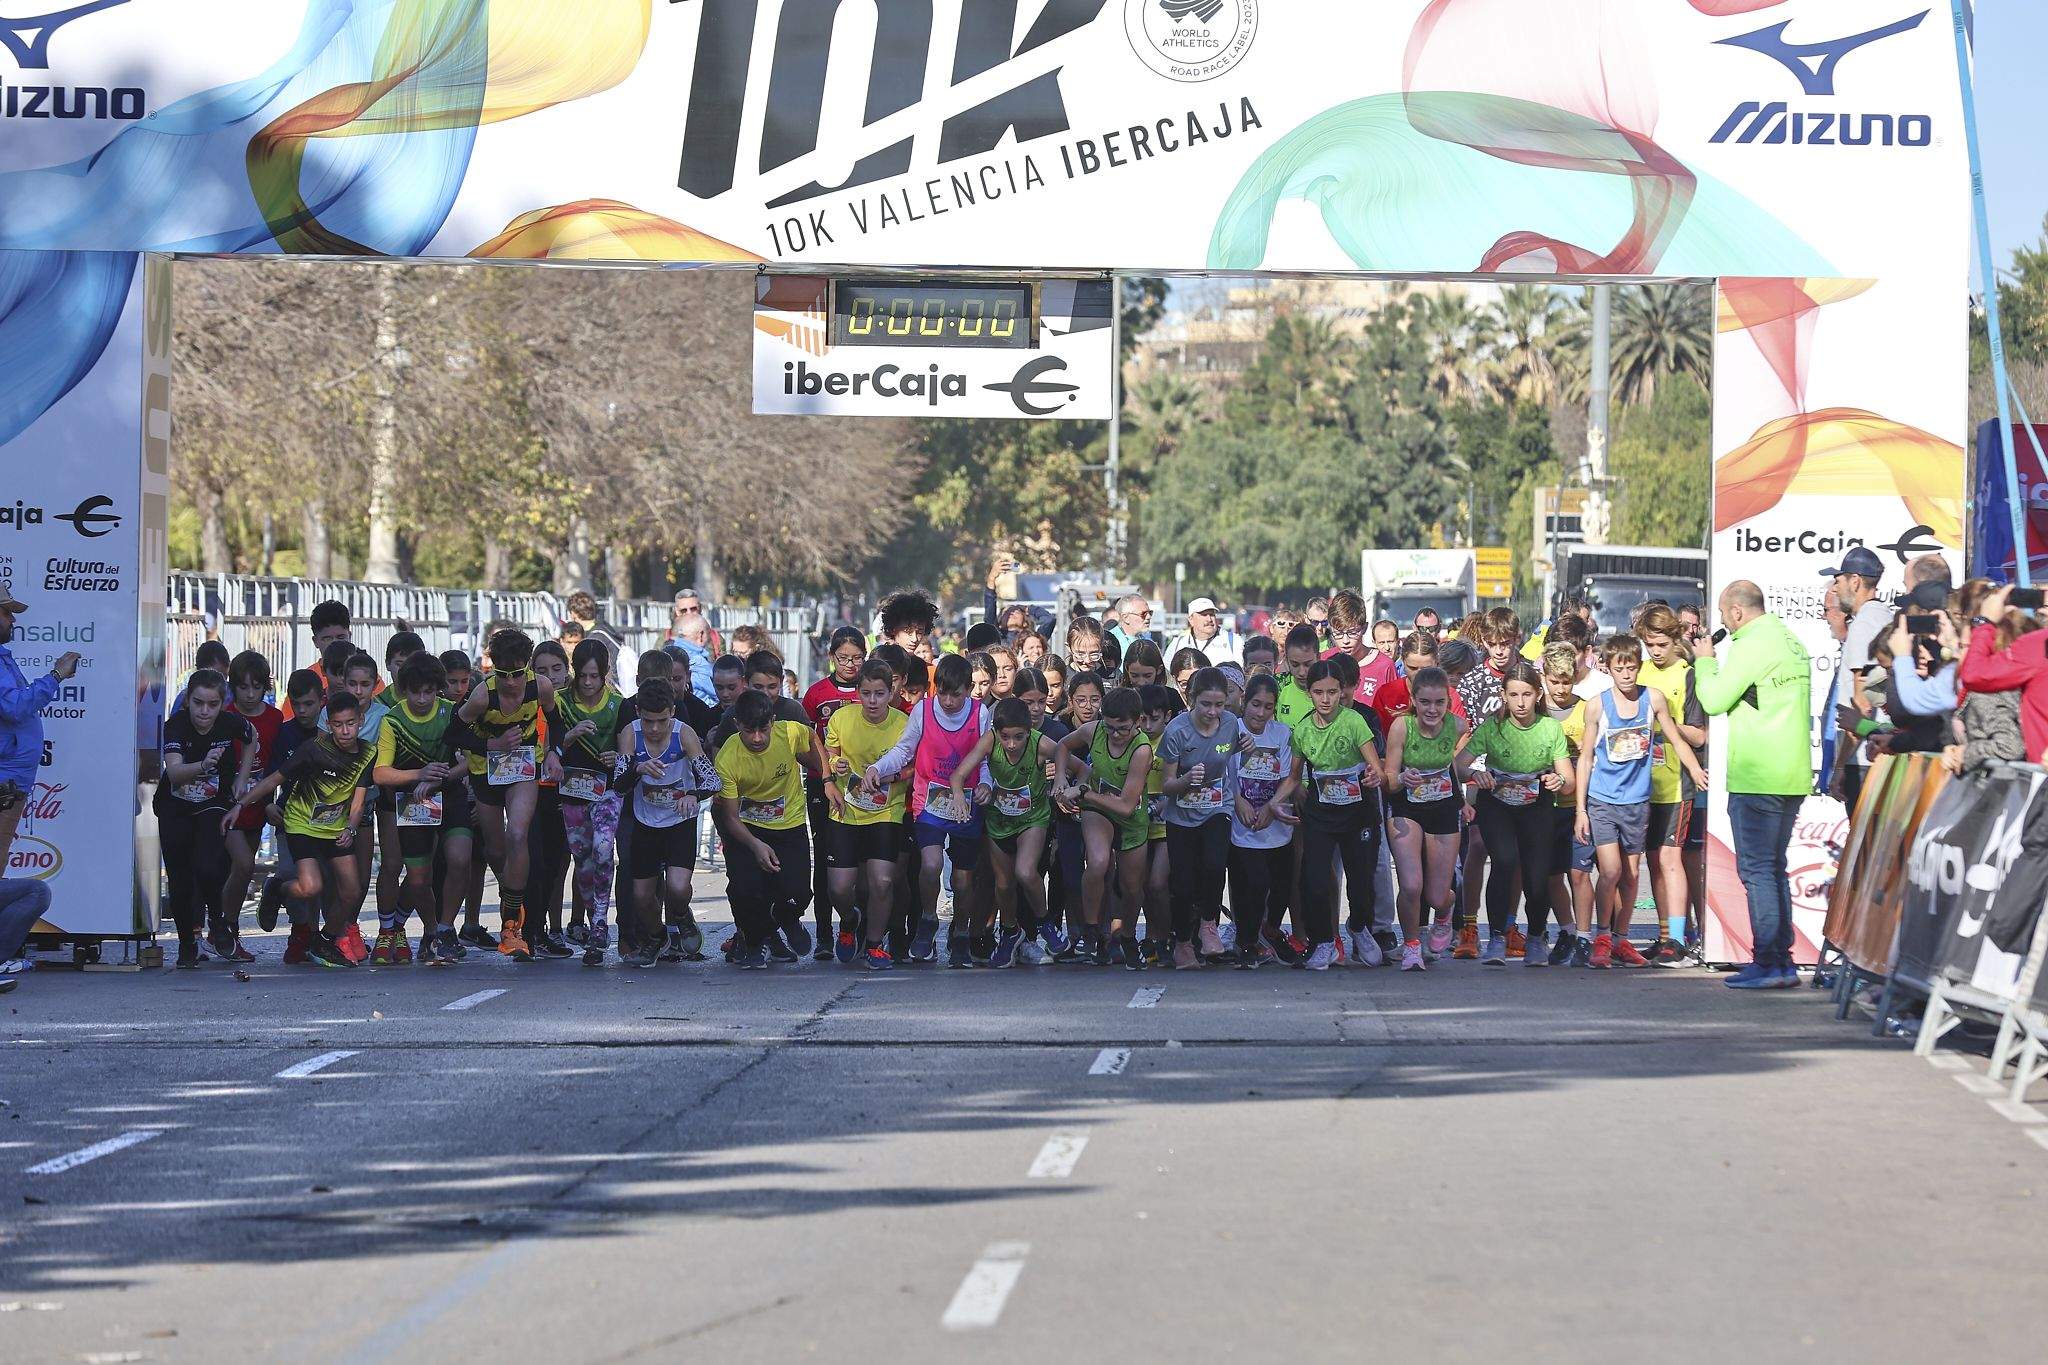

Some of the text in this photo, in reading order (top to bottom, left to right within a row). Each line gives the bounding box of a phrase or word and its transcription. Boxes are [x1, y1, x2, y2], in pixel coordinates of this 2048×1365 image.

[1162, 38, 1219, 48] ATHLETICS
[1172, 29, 1211, 38] WORLD
[1170, 65, 1200, 76] ROAD
[1202, 56, 1230, 75] RACE
[1228, 27, 1251, 59] LABEL
[0, 87, 145, 119] IZUNO
[1708, 102, 1932, 146] MIZUNO
[766, 96, 1263, 257] 10K VALENCIA IBERCAJA
[849, 298, 1017, 336] 0:00:00
[784, 361, 967, 406] iberCaja
[46, 557, 120, 575] Cultura del
[44, 574, 120, 592] Esfuerzo
[40, 705, 86, 719] Motor
